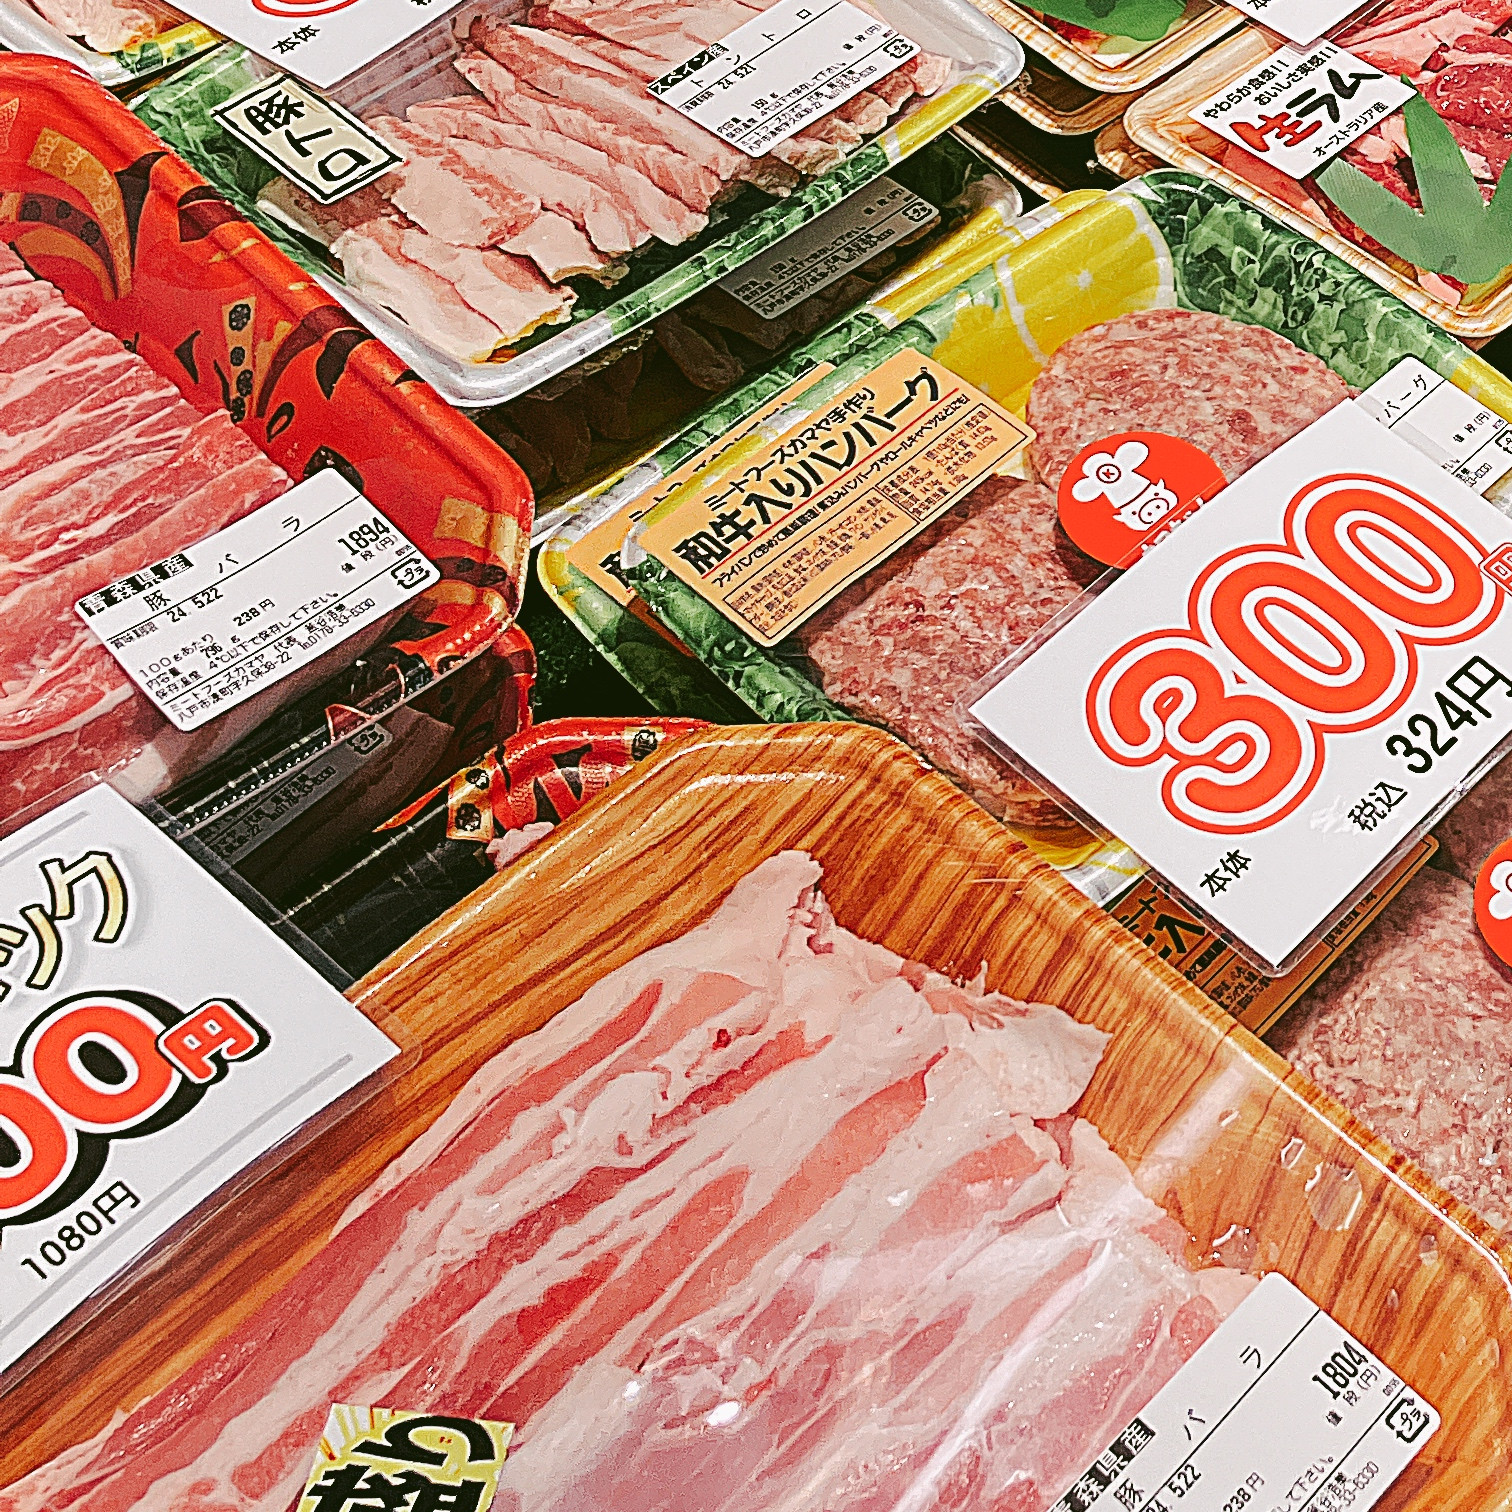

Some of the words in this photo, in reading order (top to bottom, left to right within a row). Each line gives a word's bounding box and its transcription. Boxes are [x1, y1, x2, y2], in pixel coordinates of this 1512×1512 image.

[270, 24, 321, 57] 本体
[651, 42, 730, 94] スペイン産
[689, 8, 813, 89] トントロ
[1202, 58, 1291, 120] やわらか食感!!
[1253, 46, 1339, 107] おいしさ実感!!
[244, 91, 376, 191] 豚トロ
[1228, 68, 1384, 153] 生ラム
[1311, 101, 1390, 158] オーストラリア産
[674, 364, 948, 576] 和牛入りハンバーグ
[145, 515, 302, 612] 豚バラ
[338, 516, 392, 558] 1894
[80, 552, 195, 616] 青森県産
[1347, 779, 1409, 834] 税込
[1199, 849, 1252, 899] 本体
[19, 1180, 142, 1282] 1080円
[1311, 1342, 1374, 1404] 1804
